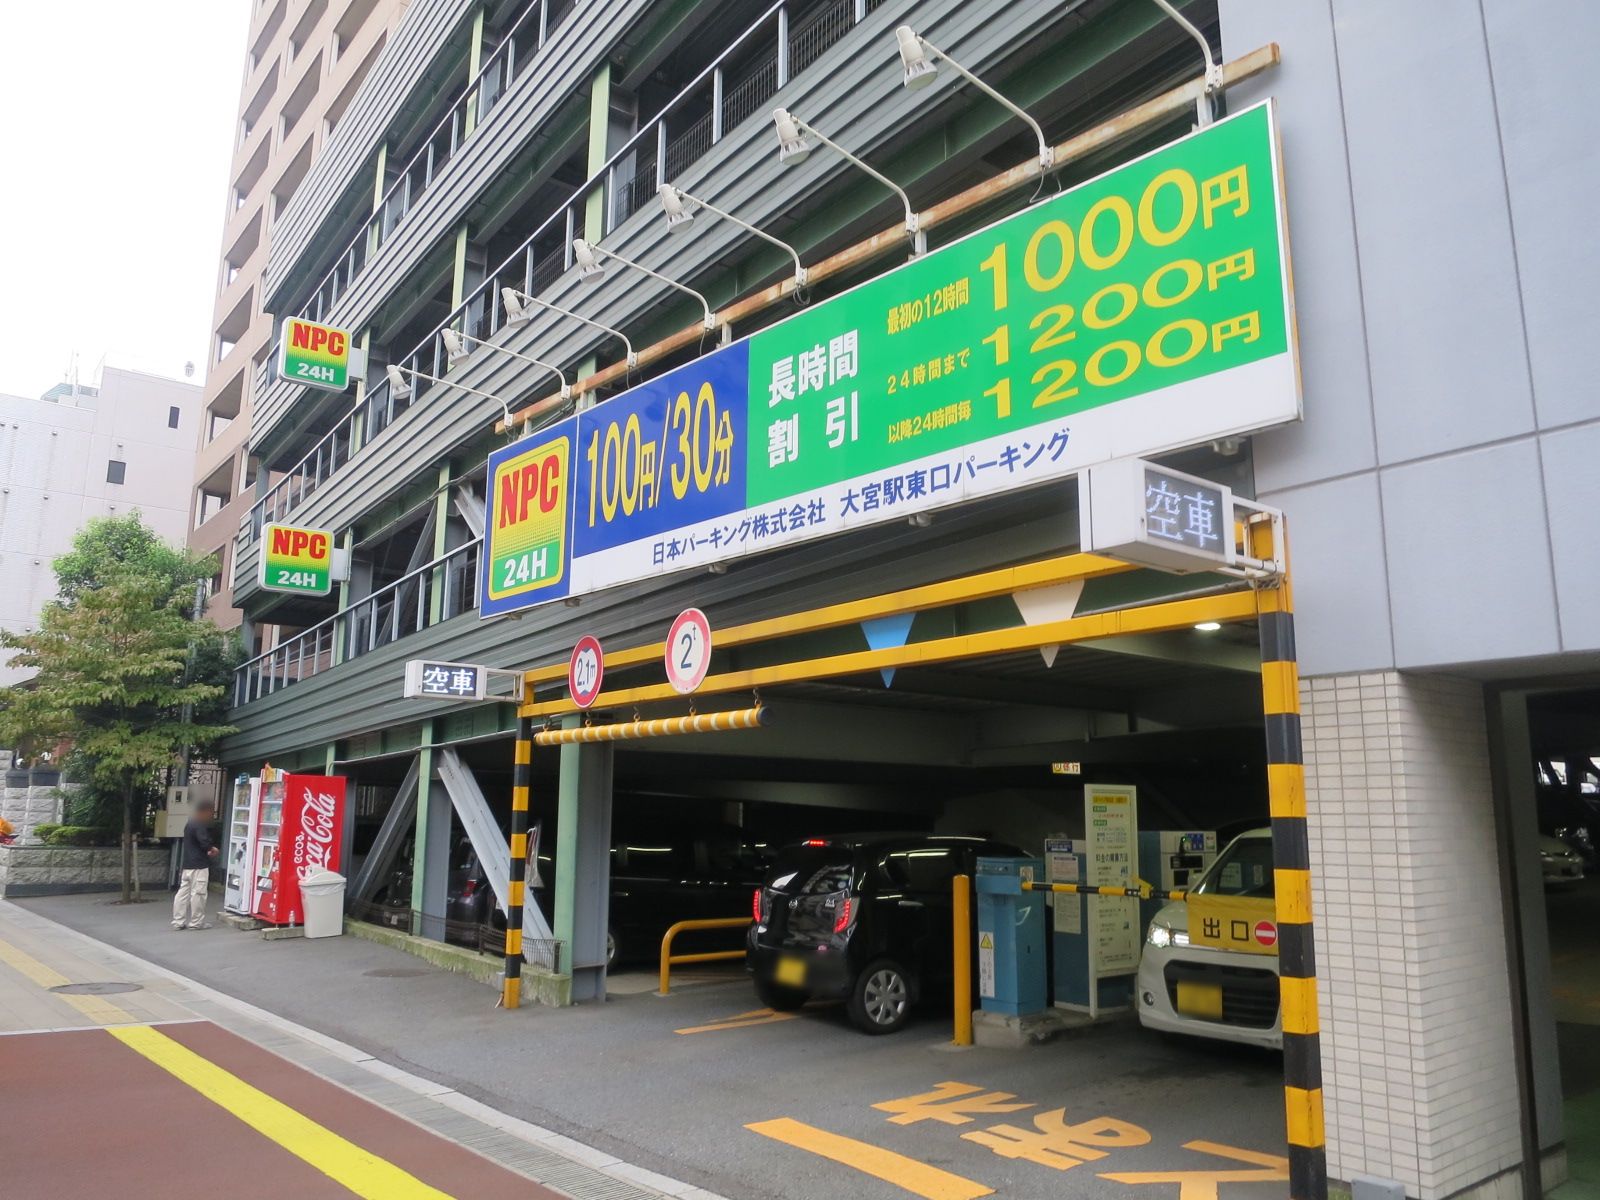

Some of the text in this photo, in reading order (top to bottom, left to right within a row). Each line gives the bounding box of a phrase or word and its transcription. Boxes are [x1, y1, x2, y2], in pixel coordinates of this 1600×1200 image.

[887, 164, 1250, 335] 最初の12時間 1000円
[292, 322, 345, 356] NPC
[887, 248, 1255, 395] 24時間まで 1200円
[297, 362, 335, 382] 24H
[769, 329, 858, 408] 長時間
[888, 310, 1260, 444] 以降24時間毎 1200円
[587, 382, 734, 528] 100円/30分
[499, 454, 560, 529] NPC
[653, 428, 1070, 565] 日本パーキング株式会社 大宮駅東口パーキング
[1146, 480, 1218, 547] 空車
[272, 528, 326, 559] NPC
[503, 547, 548, 588] 24H
[277, 570, 316, 588] 24H
[423, 666, 474, 696] 空車
[577, 657, 596, 687] 2.1m
[1203, 917, 1249, 942] 出口
